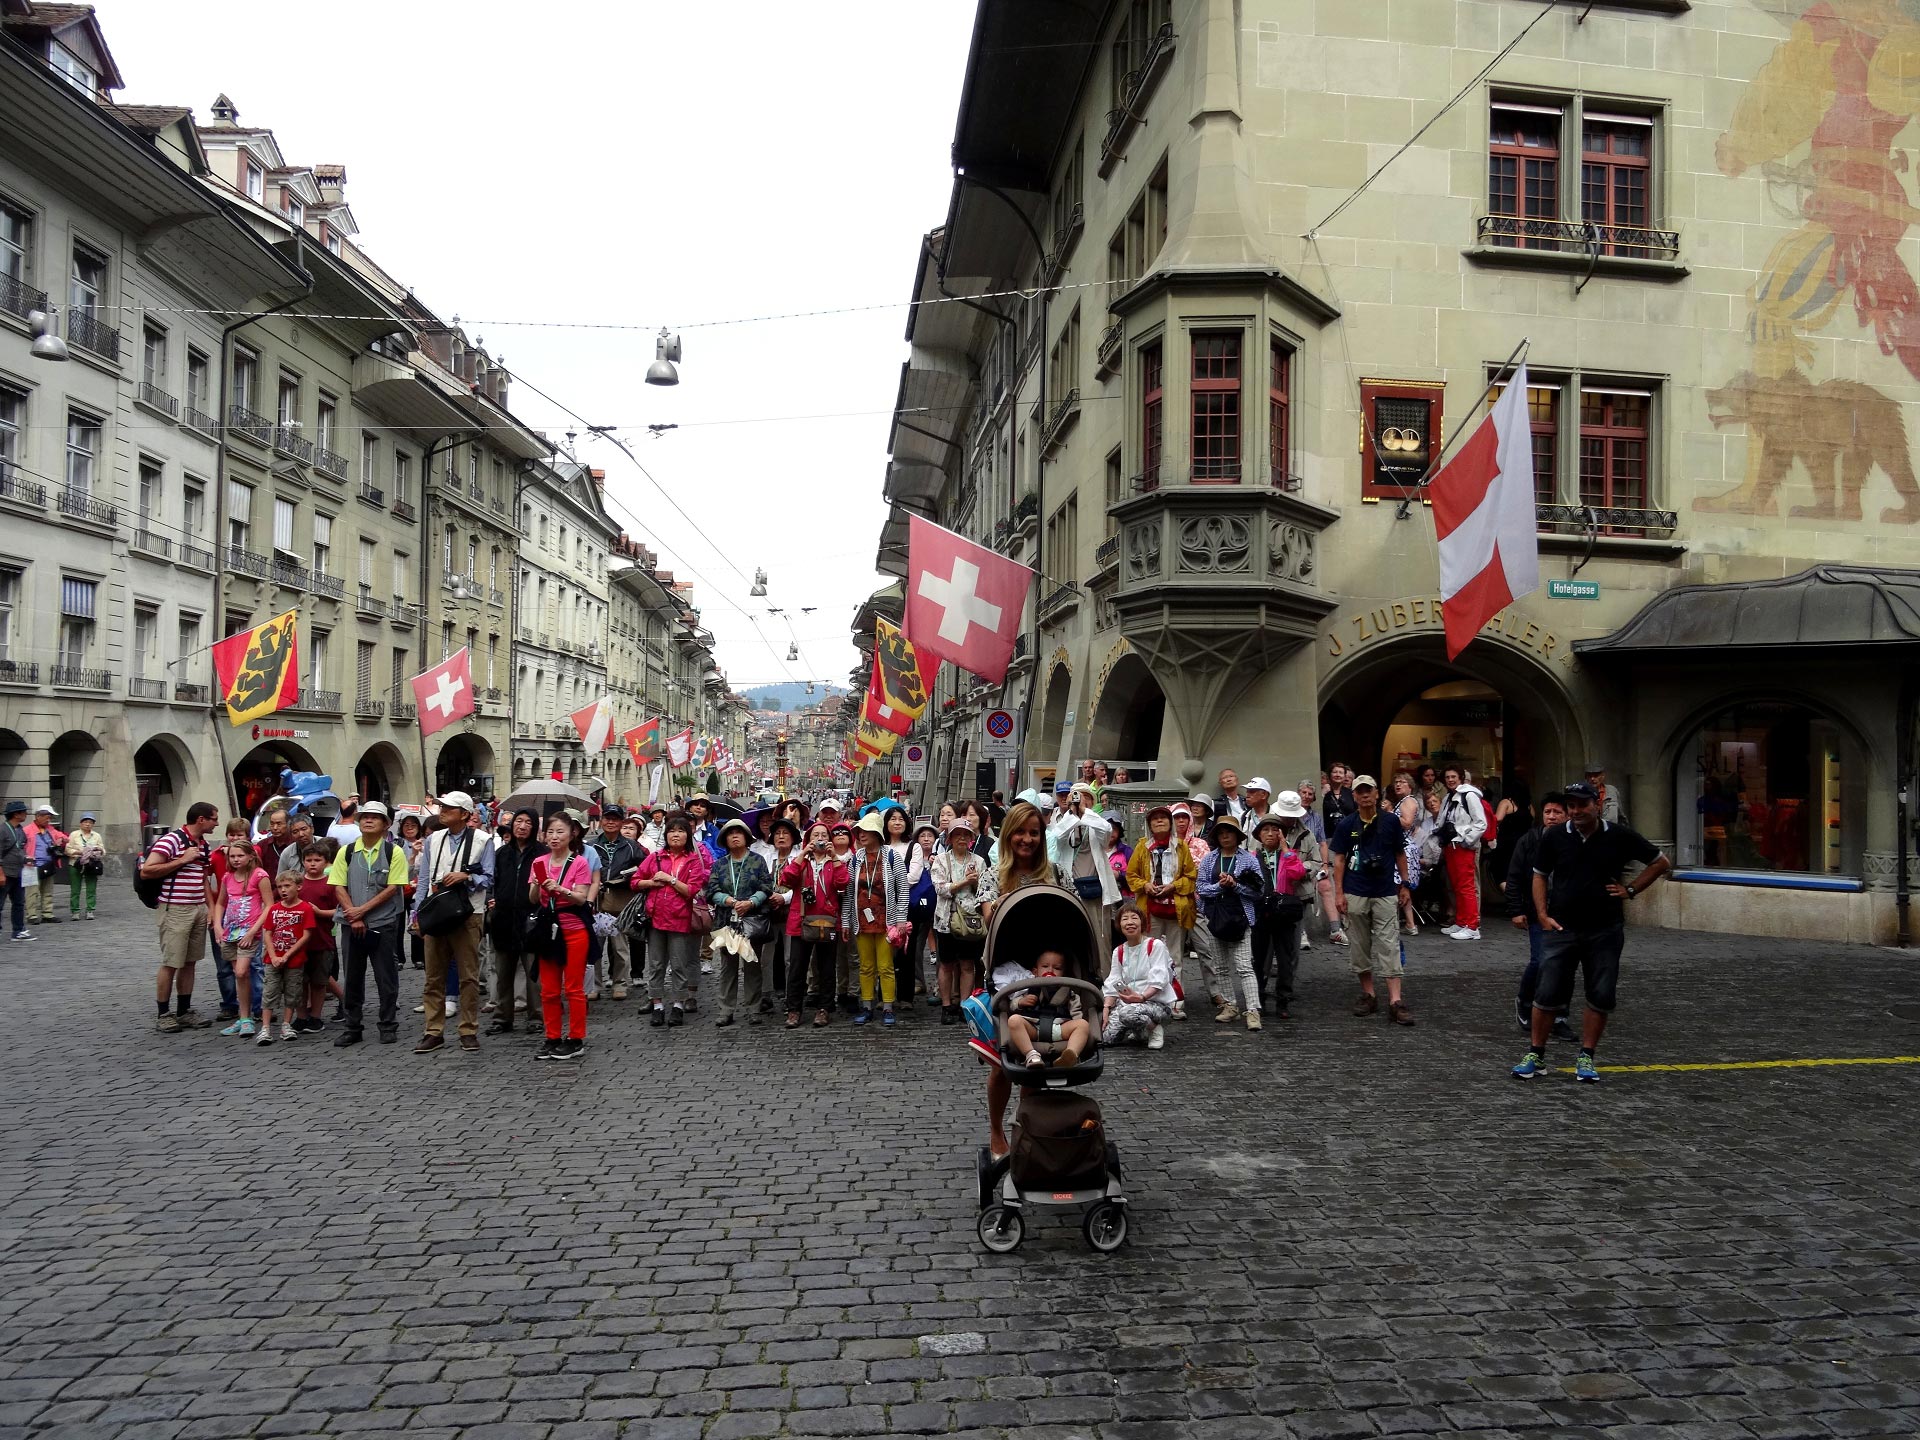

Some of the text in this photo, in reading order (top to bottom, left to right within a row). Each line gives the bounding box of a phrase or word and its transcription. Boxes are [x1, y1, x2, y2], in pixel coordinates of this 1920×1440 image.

[1553, 583, 1595, 596] Hotelgasse
[1329, 633, 1354, 657] J.
[1353, 598, 1557, 659] ZUBERHLER
[1696, 753, 1744, 775] SALE
